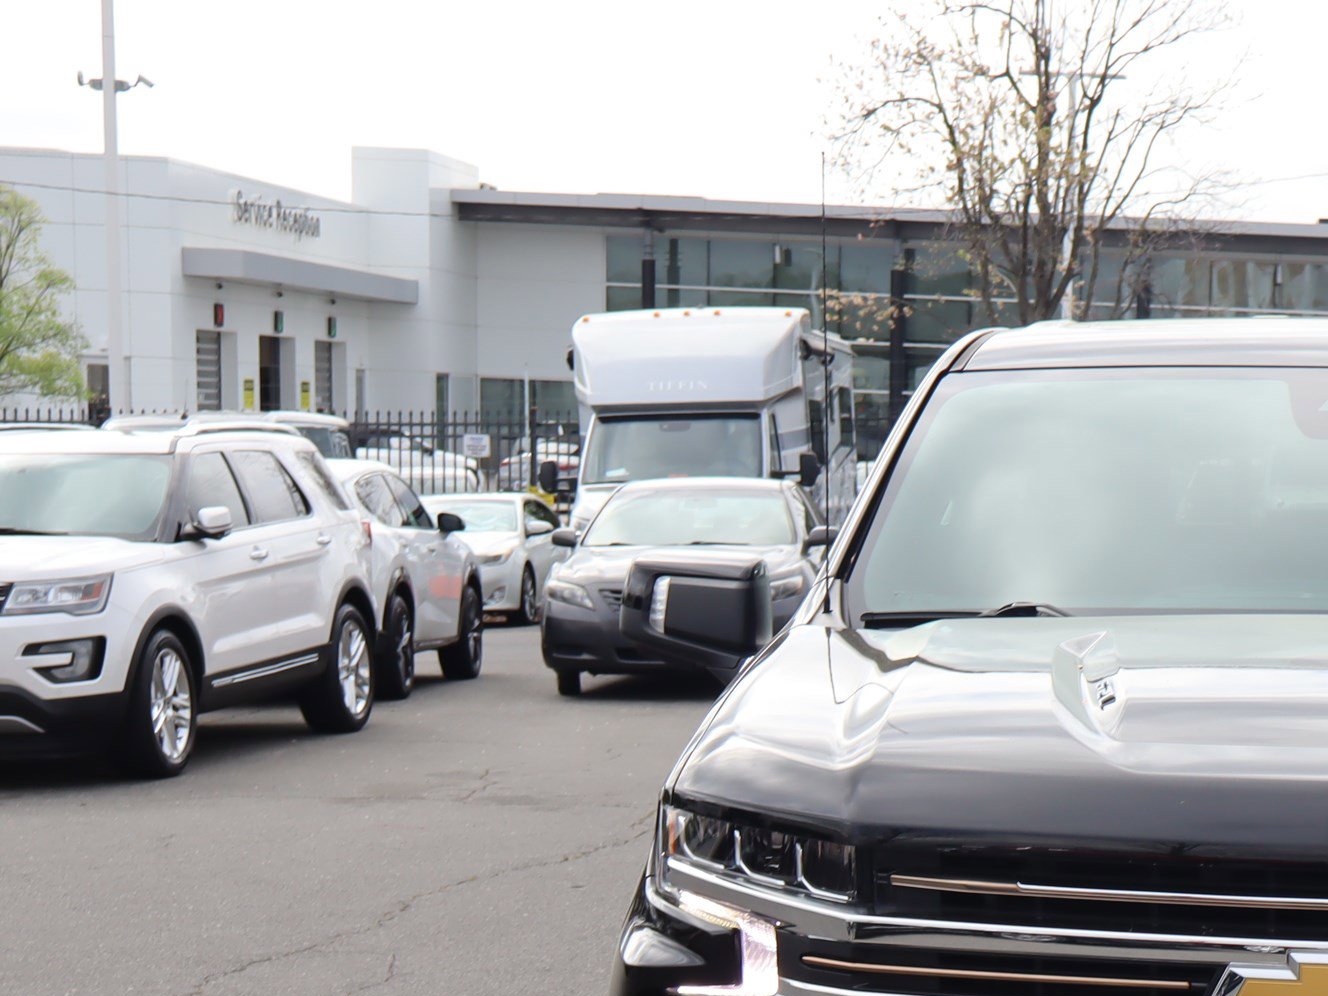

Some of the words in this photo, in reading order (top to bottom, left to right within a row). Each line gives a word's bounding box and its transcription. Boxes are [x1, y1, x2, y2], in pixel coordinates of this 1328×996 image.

[235, 189, 273, 228] Service
[275, 199, 321, 241] Reception
[647, 379, 709, 392] TIFFIN
